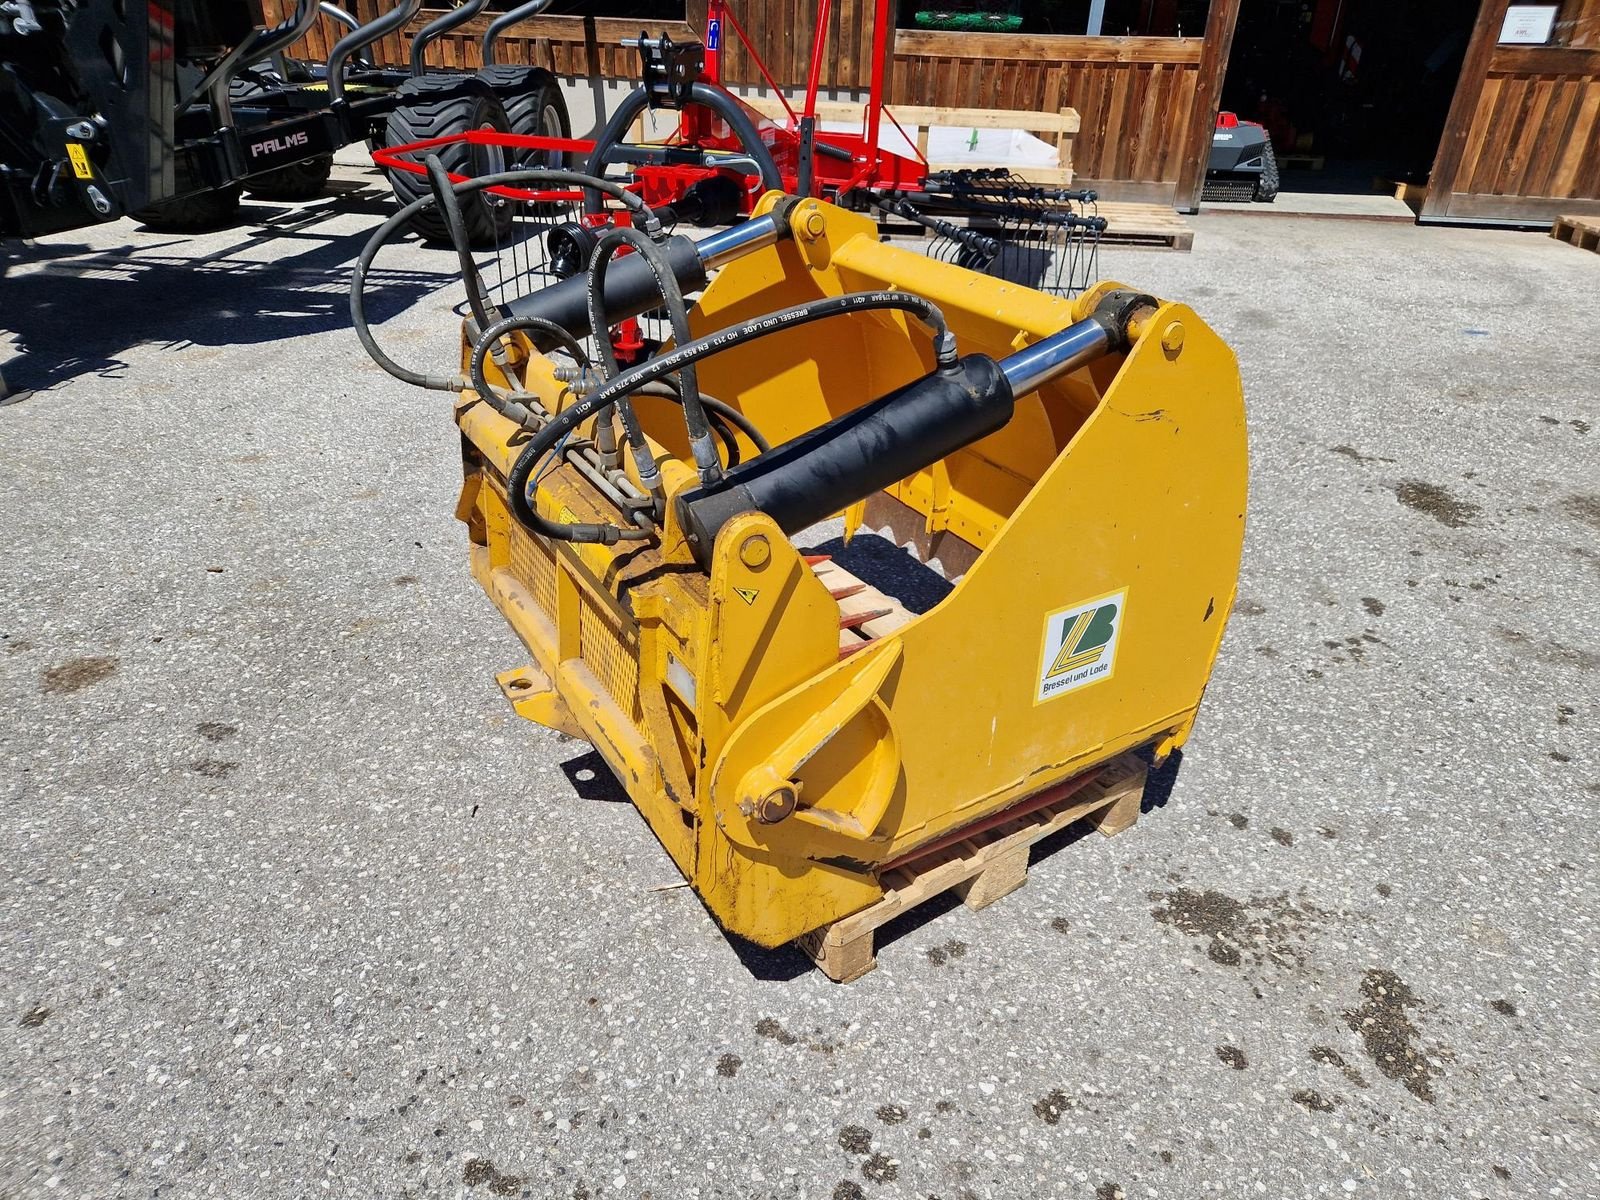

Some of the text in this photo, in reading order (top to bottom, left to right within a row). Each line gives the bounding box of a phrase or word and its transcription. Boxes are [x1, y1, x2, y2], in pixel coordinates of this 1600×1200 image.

[251, 131, 309, 157] PALMS
[575, 308, 808, 415] BRESSEL UND LADE HD 213 EN 853 2SN 12 WP 275 BAR 4Q11
[1043, 663, 1108, 694] Bressel und Lade
